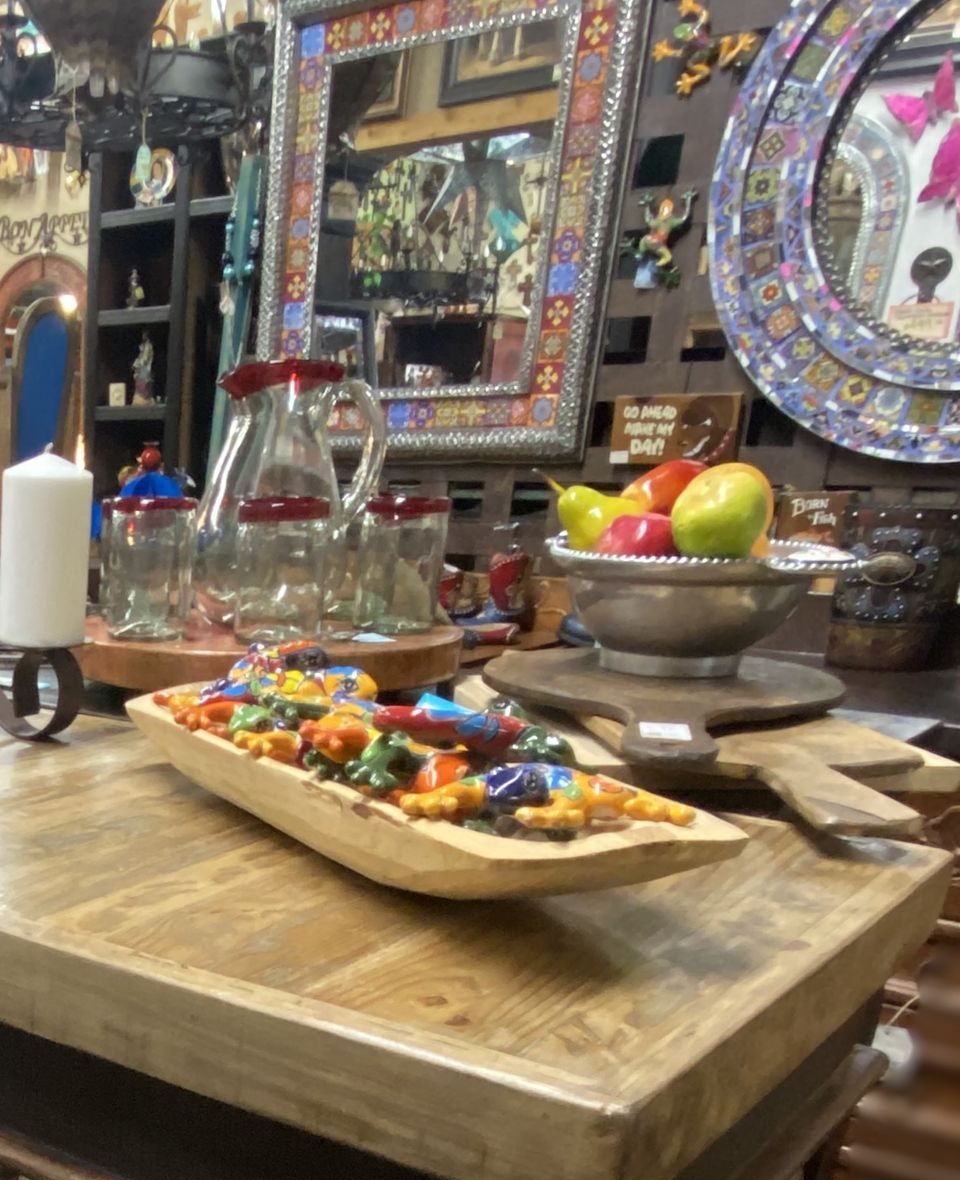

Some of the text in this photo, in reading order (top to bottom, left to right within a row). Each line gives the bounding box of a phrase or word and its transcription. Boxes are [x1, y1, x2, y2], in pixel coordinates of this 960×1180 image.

[623, 405, 678, 420] GO AHEAD
[624, 421, 675, 436] MAKE MY
[630, 438, 666, 456] DAY!
